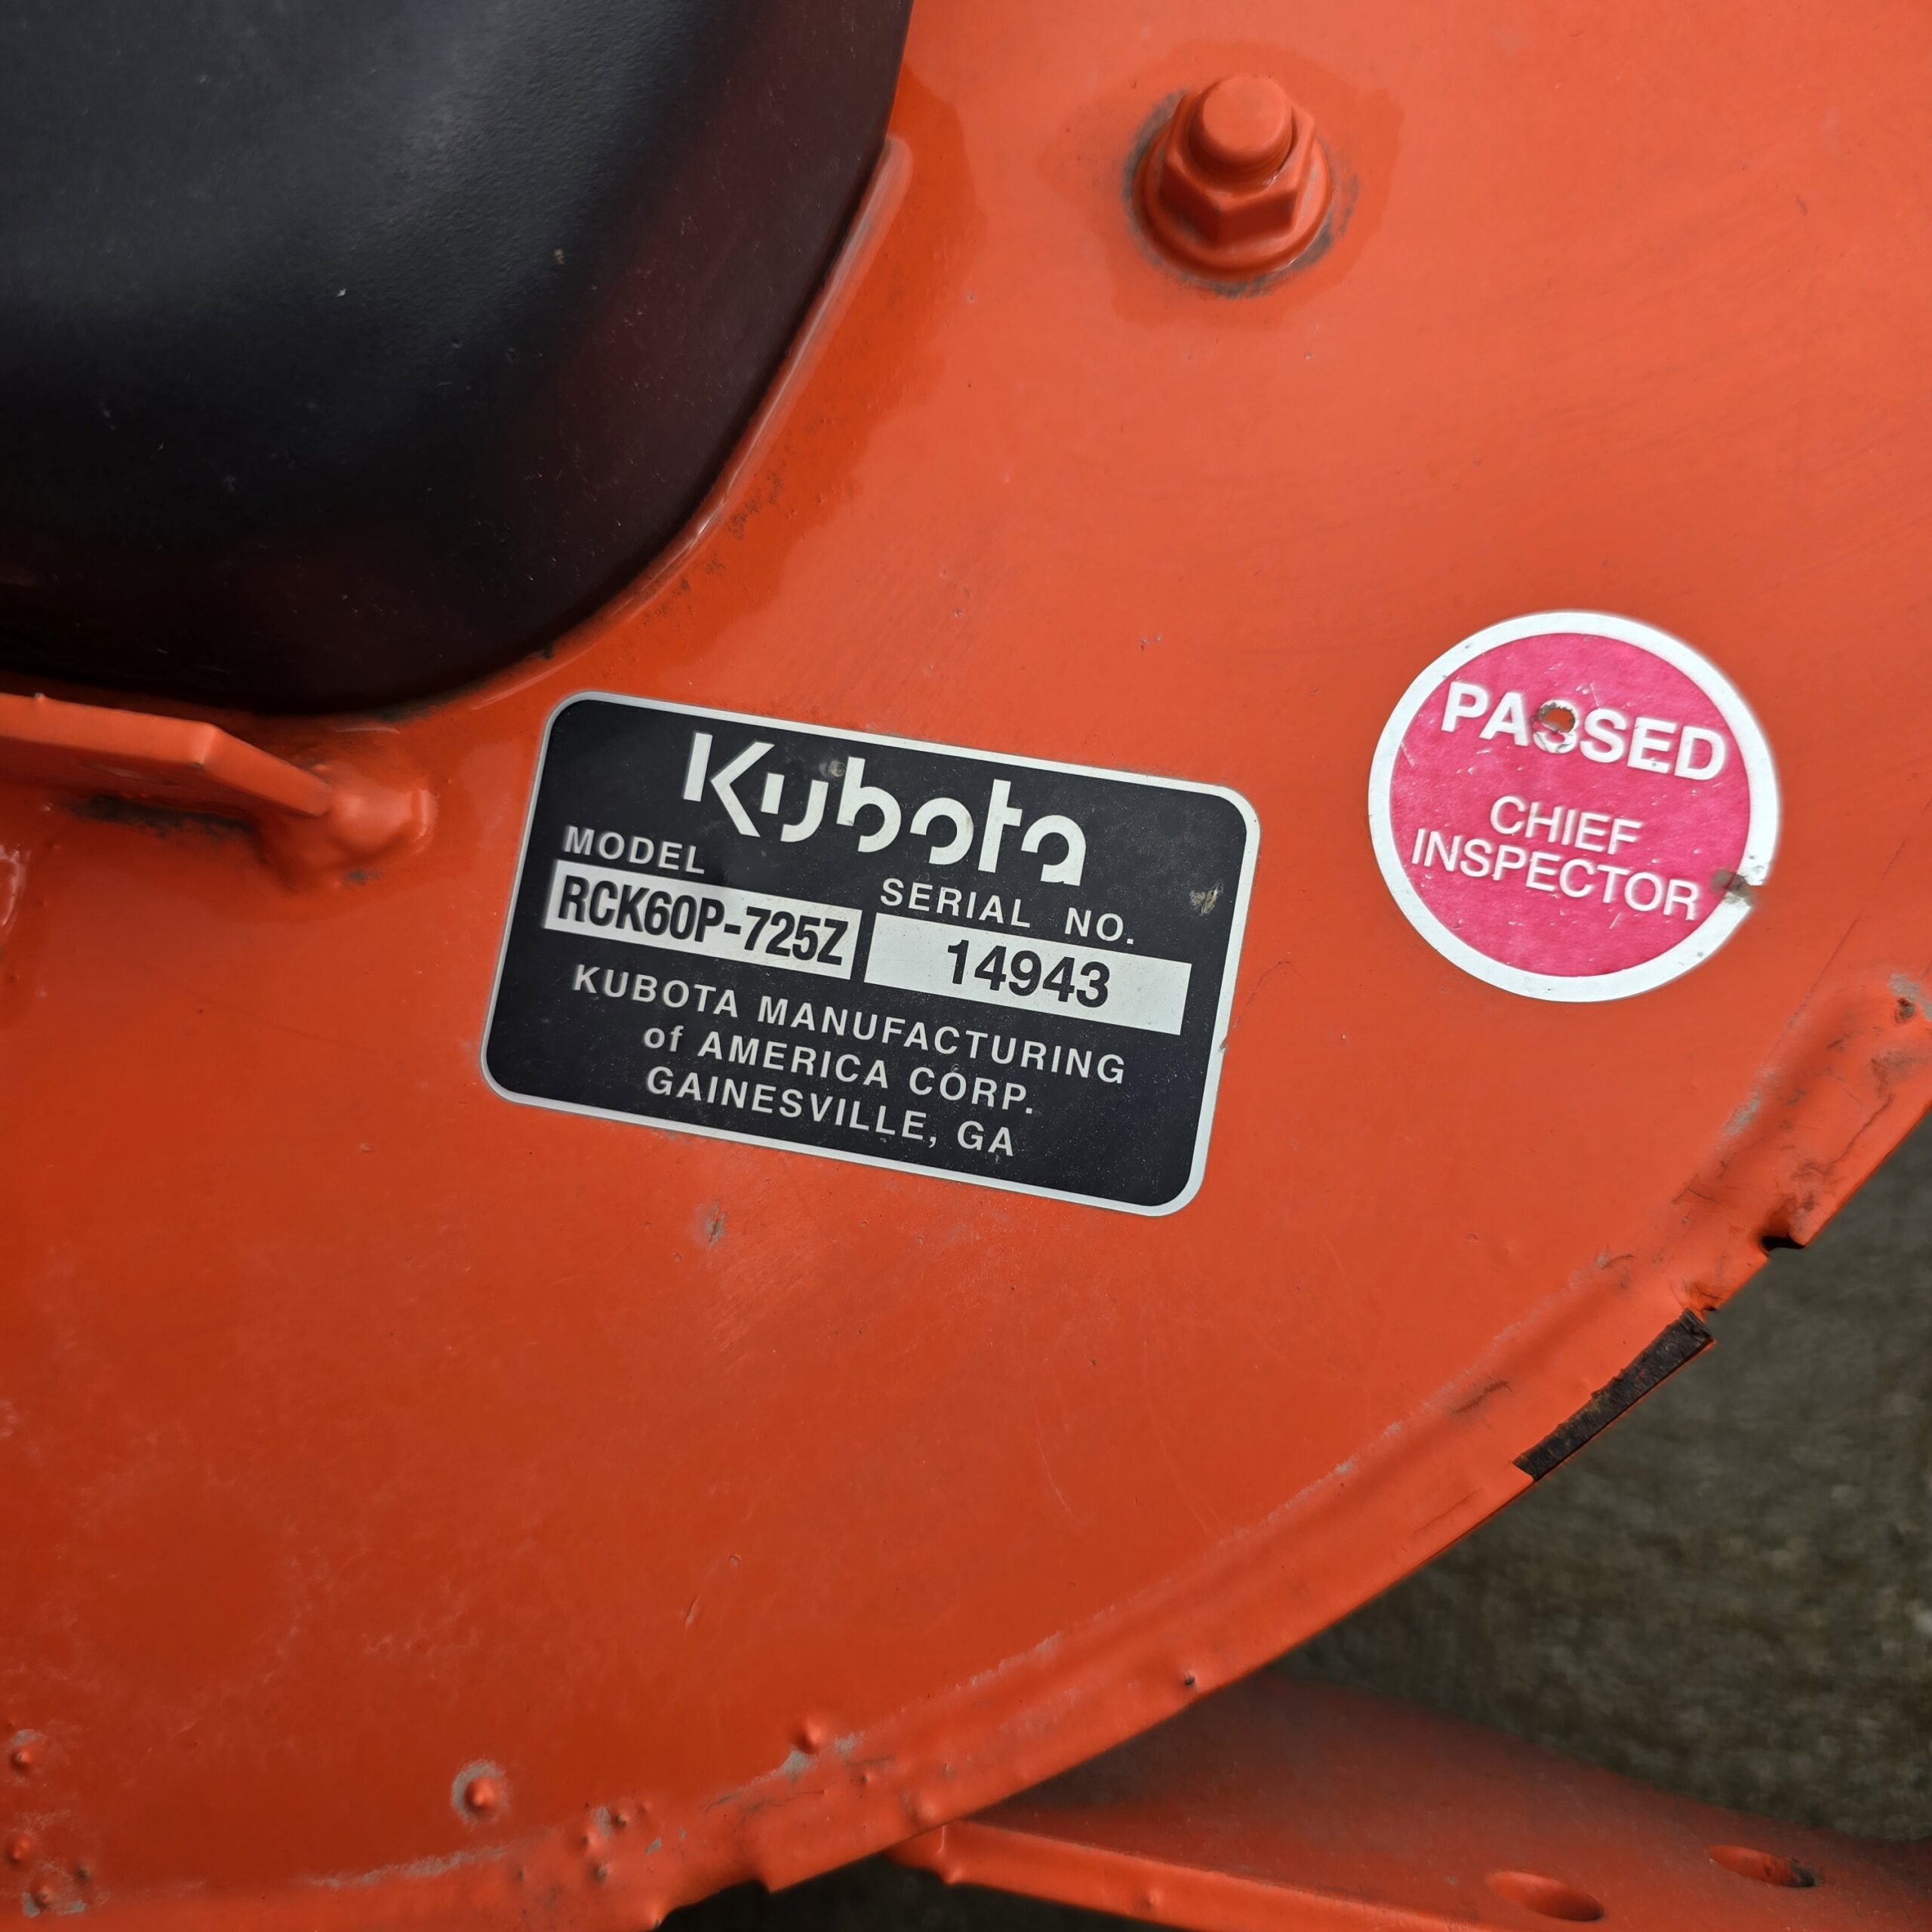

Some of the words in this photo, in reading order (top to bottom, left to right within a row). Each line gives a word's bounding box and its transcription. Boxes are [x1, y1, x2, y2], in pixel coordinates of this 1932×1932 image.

[564, 825, 706, 874] MODEL
[682, 732, 1087, 887] Kubota
[1490, 795, 1643, 855] CHIEF
[880, 878, 1032, 928] SERIAL
[1064, 906, 1136, 946] NO.
[1411, 828, 1701, 921] INSPECTOR
[558, 874, 850, 966] RCK60P-725Z
[947, 939, 1110, 1008] 14943
[574, 964, 739, 1019] KUBOTA
[757, 995, 1124, 1084] MANUFACTURING
[644, 1025, 684, 1052] of
[697, 1031, 889, 1090] AMERICA
[909, 1066, 1034, 1115] CORP.
[647, 1066, 937, 1148] GAINESVILLE,
[957, 1120, 1014, 1157] GA
